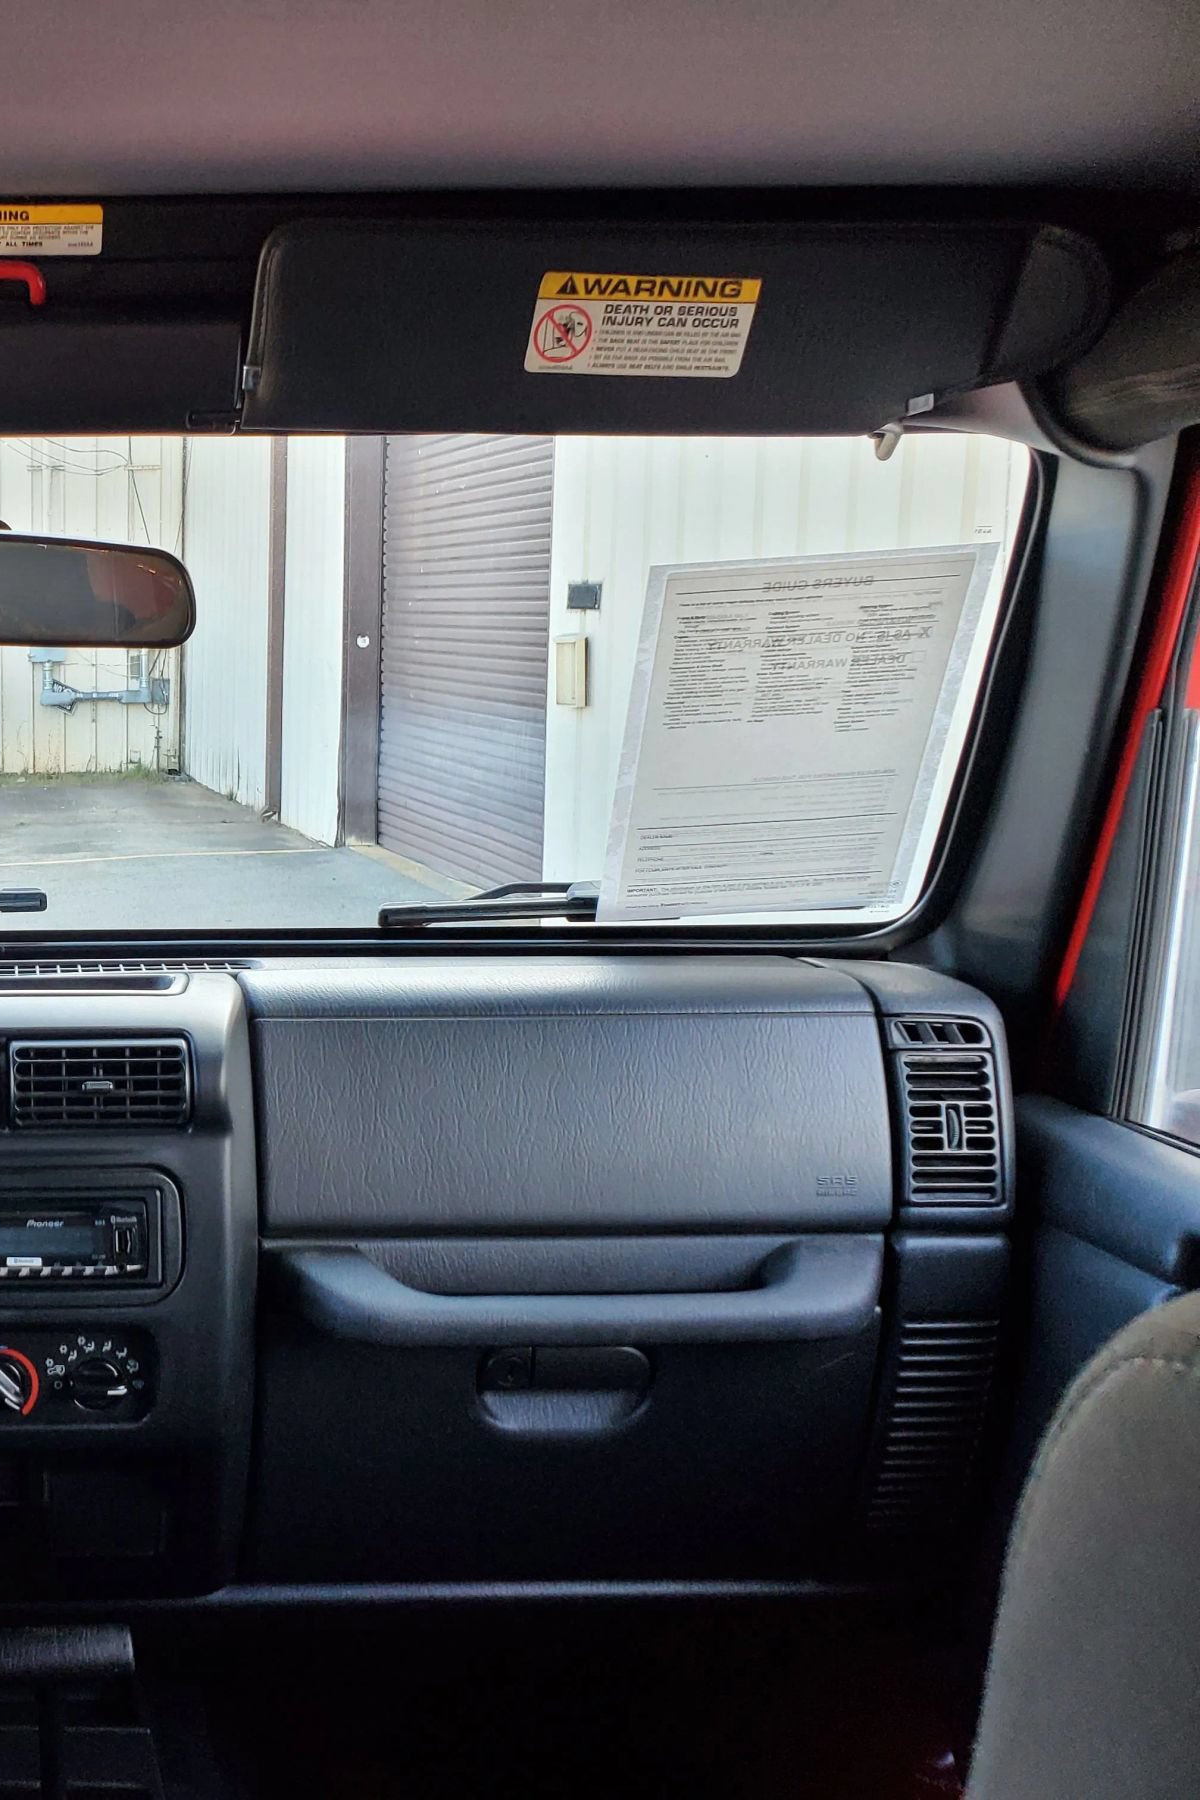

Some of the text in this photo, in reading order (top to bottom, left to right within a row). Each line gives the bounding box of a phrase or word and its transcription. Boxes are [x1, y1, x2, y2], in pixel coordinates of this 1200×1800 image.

[583, 278, 742, 298] WARNING
[603, 304, 738, 317] DEATH OR SERIOUS
[601, 317, 739, 329] INJURY CAN OCCUR
[26, 1219, 64, 1229] Pioneer
